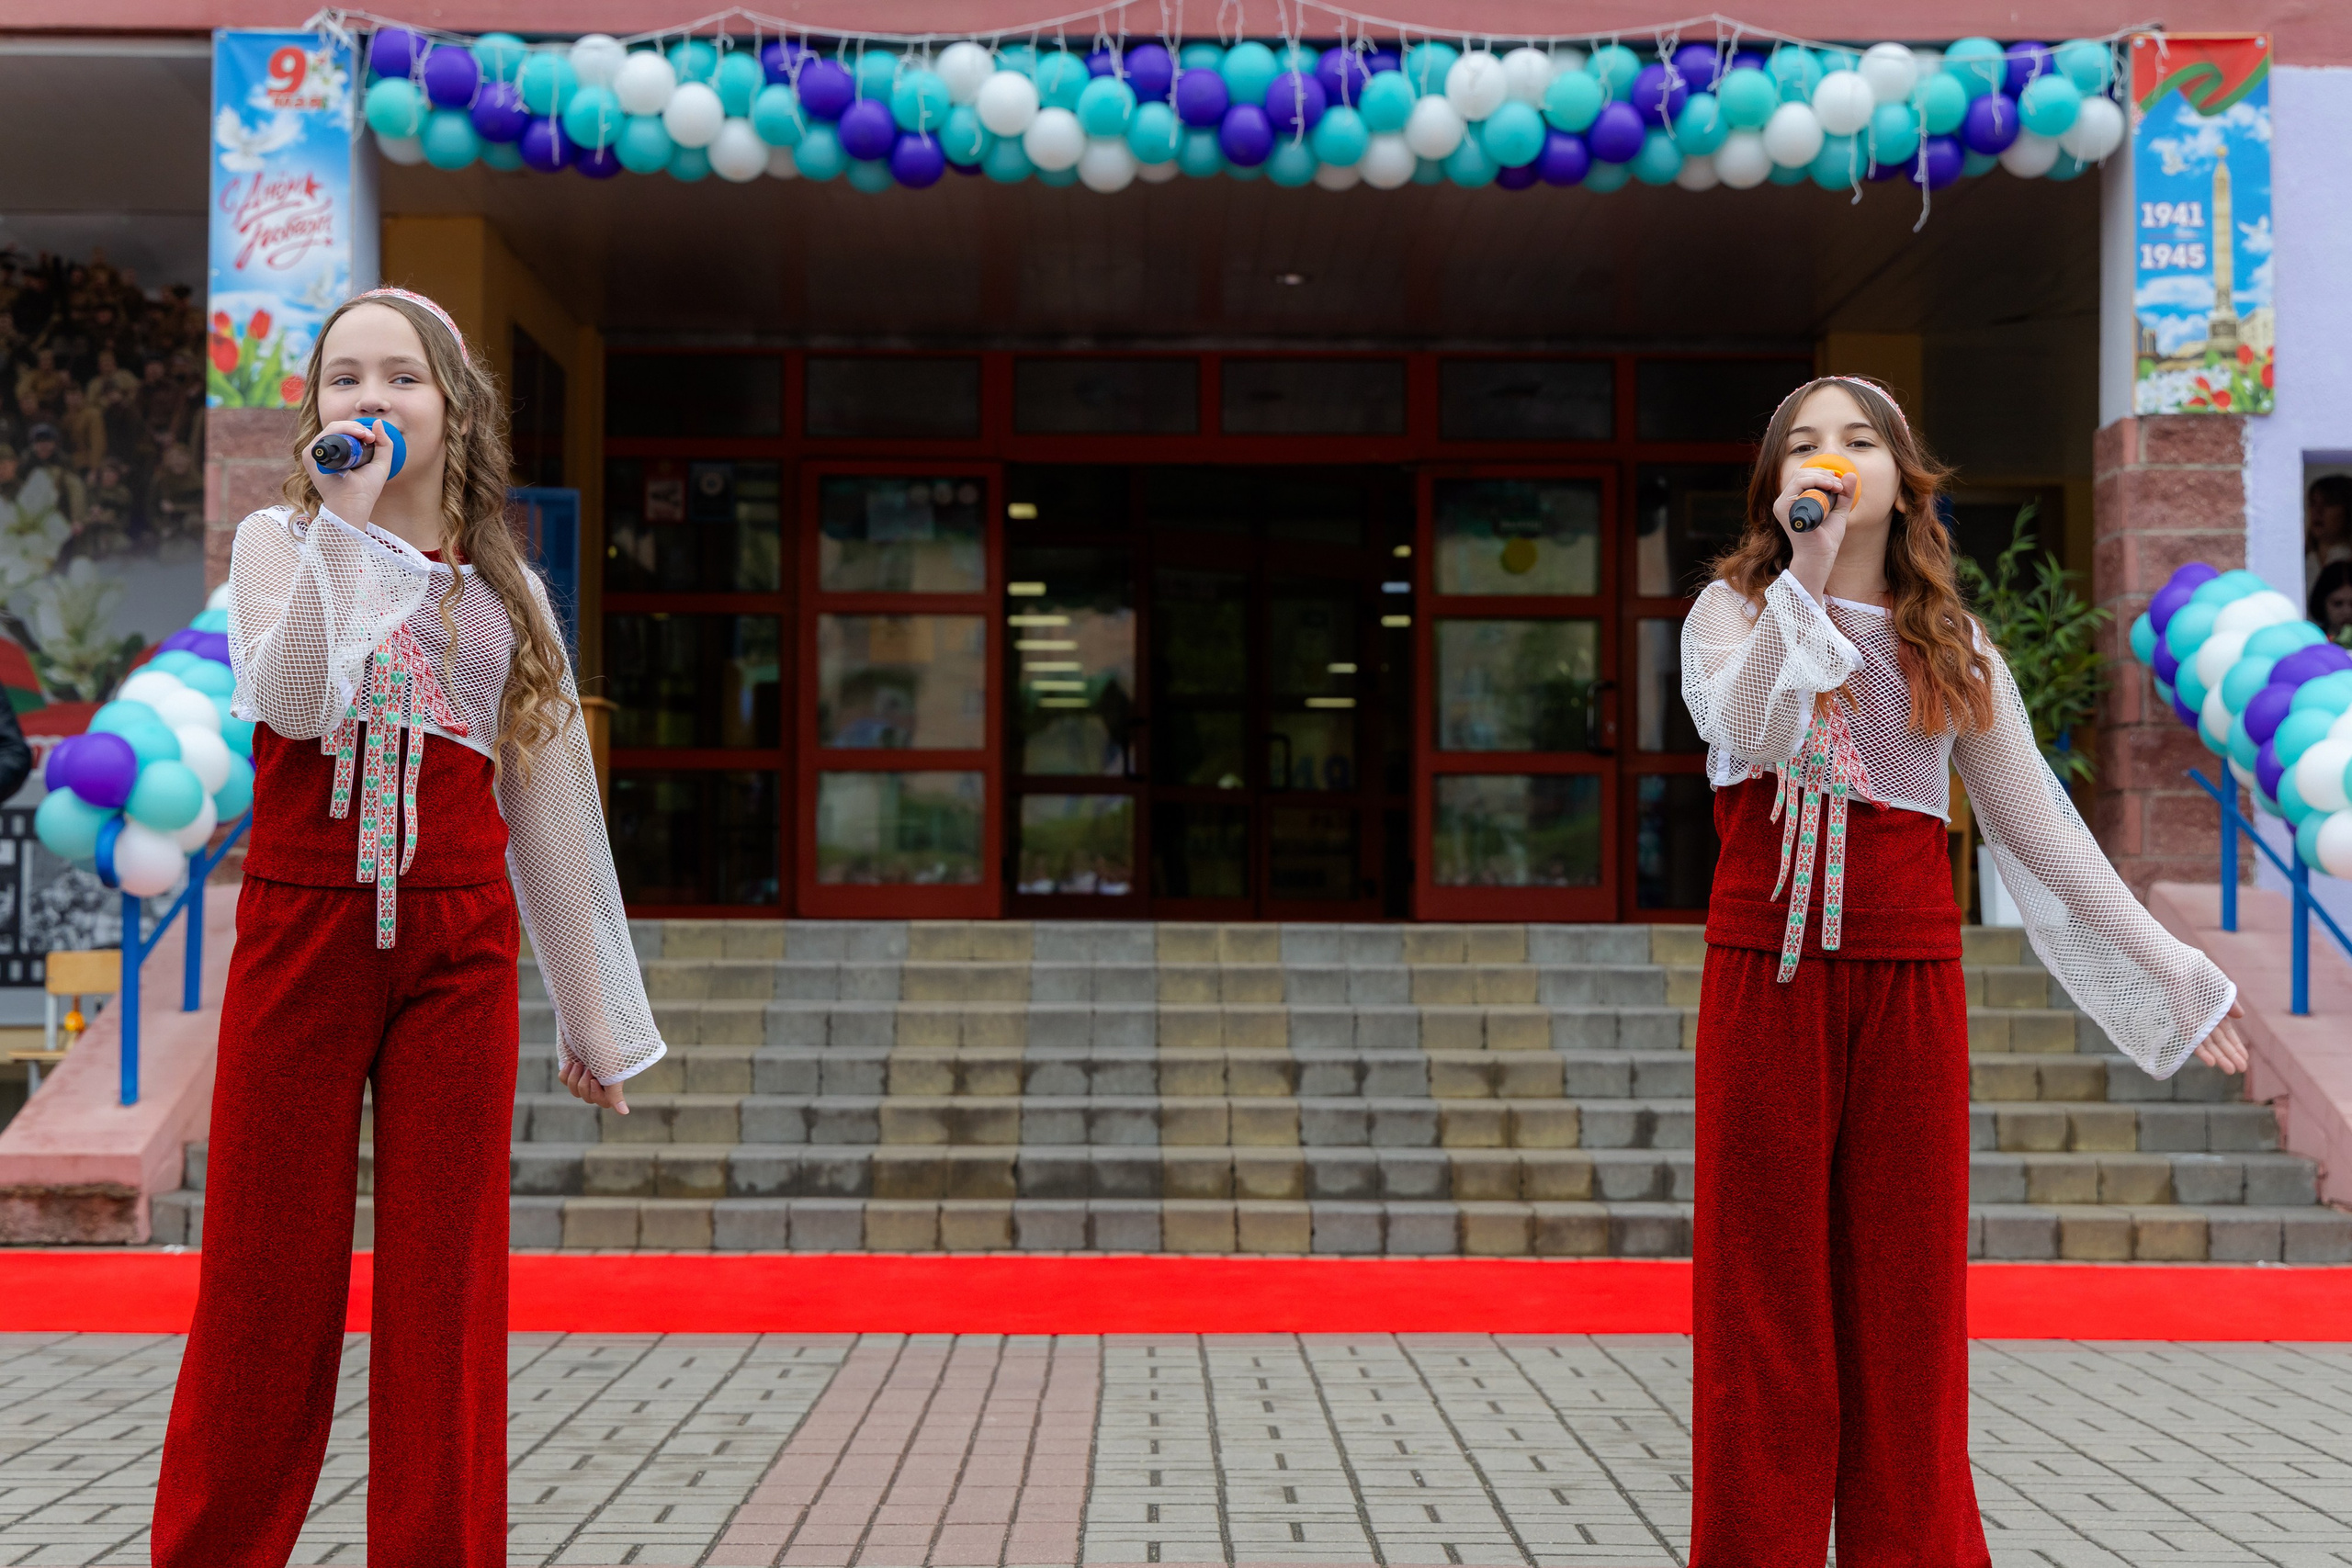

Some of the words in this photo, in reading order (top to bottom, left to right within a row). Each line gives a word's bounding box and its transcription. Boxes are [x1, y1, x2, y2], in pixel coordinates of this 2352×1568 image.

[268, 46, 306, 95] 9
[2141, 201, 2204, 228] 1941
[2140, 243, 2206, 269] 1945
